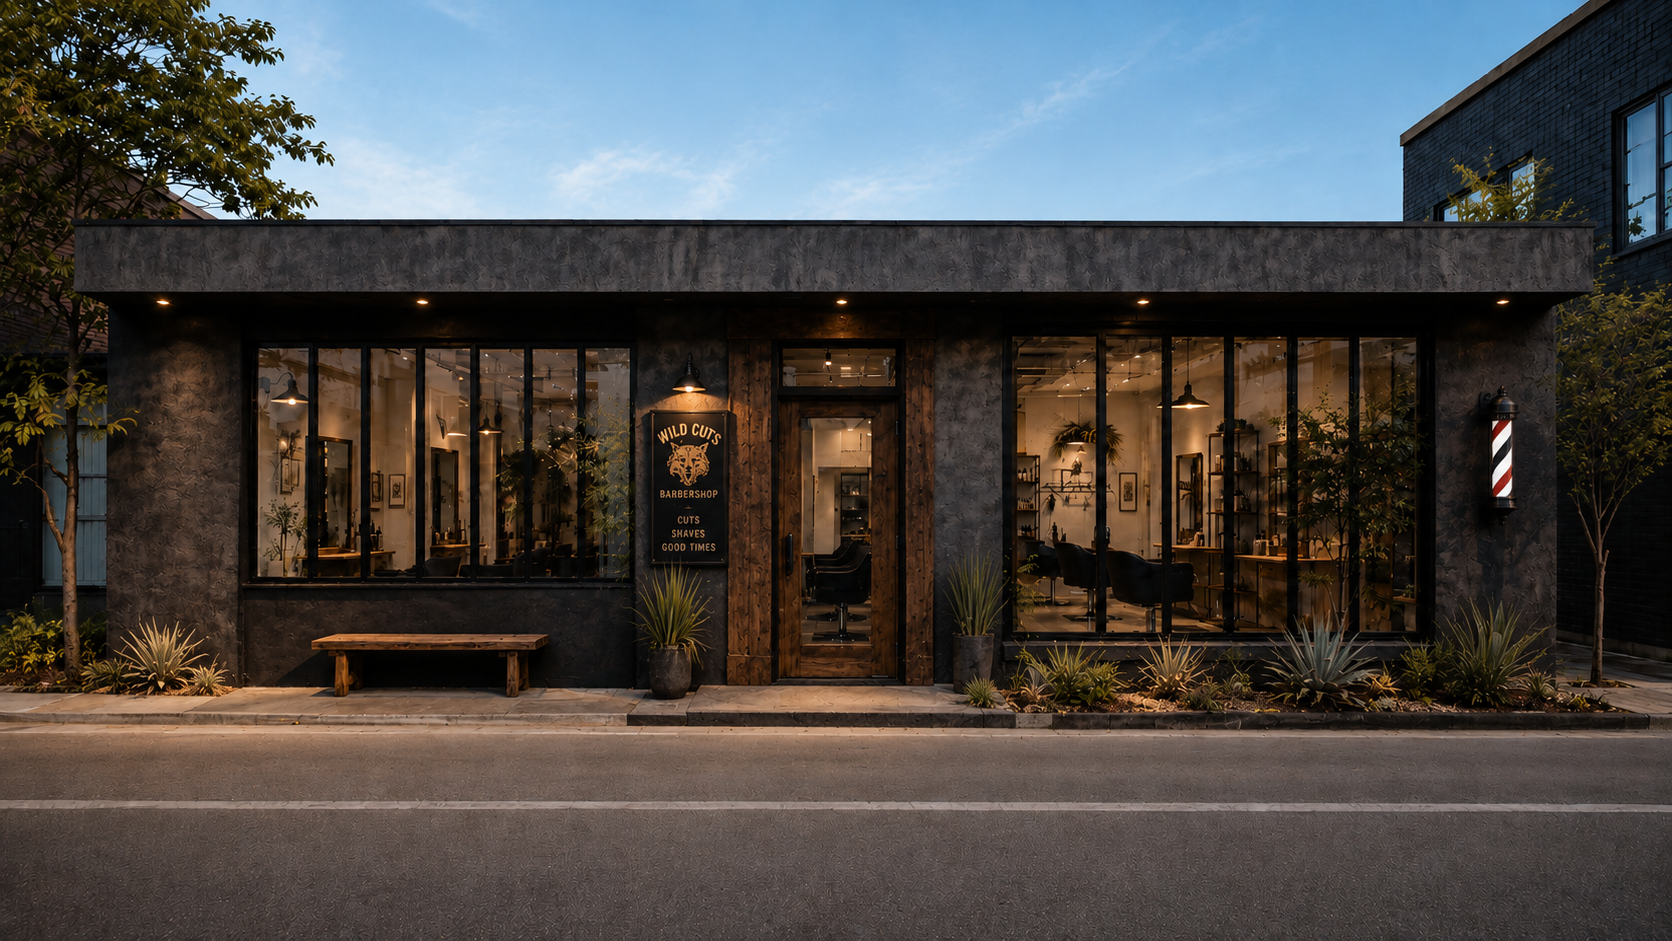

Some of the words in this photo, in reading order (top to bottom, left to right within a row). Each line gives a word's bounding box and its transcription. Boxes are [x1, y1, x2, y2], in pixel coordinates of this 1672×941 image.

[657, 423, 688, 444] WILD
[691, 423, 722, 445] CUTS
[659, 490, 718, 499] BARBERSHOP
[677, 516, 700, 525] CUTS
[671, 529, 705, 538] SHAVES
[661, 543, 686, 552] GOOD
[689, 543, 716, 552] TIMES
